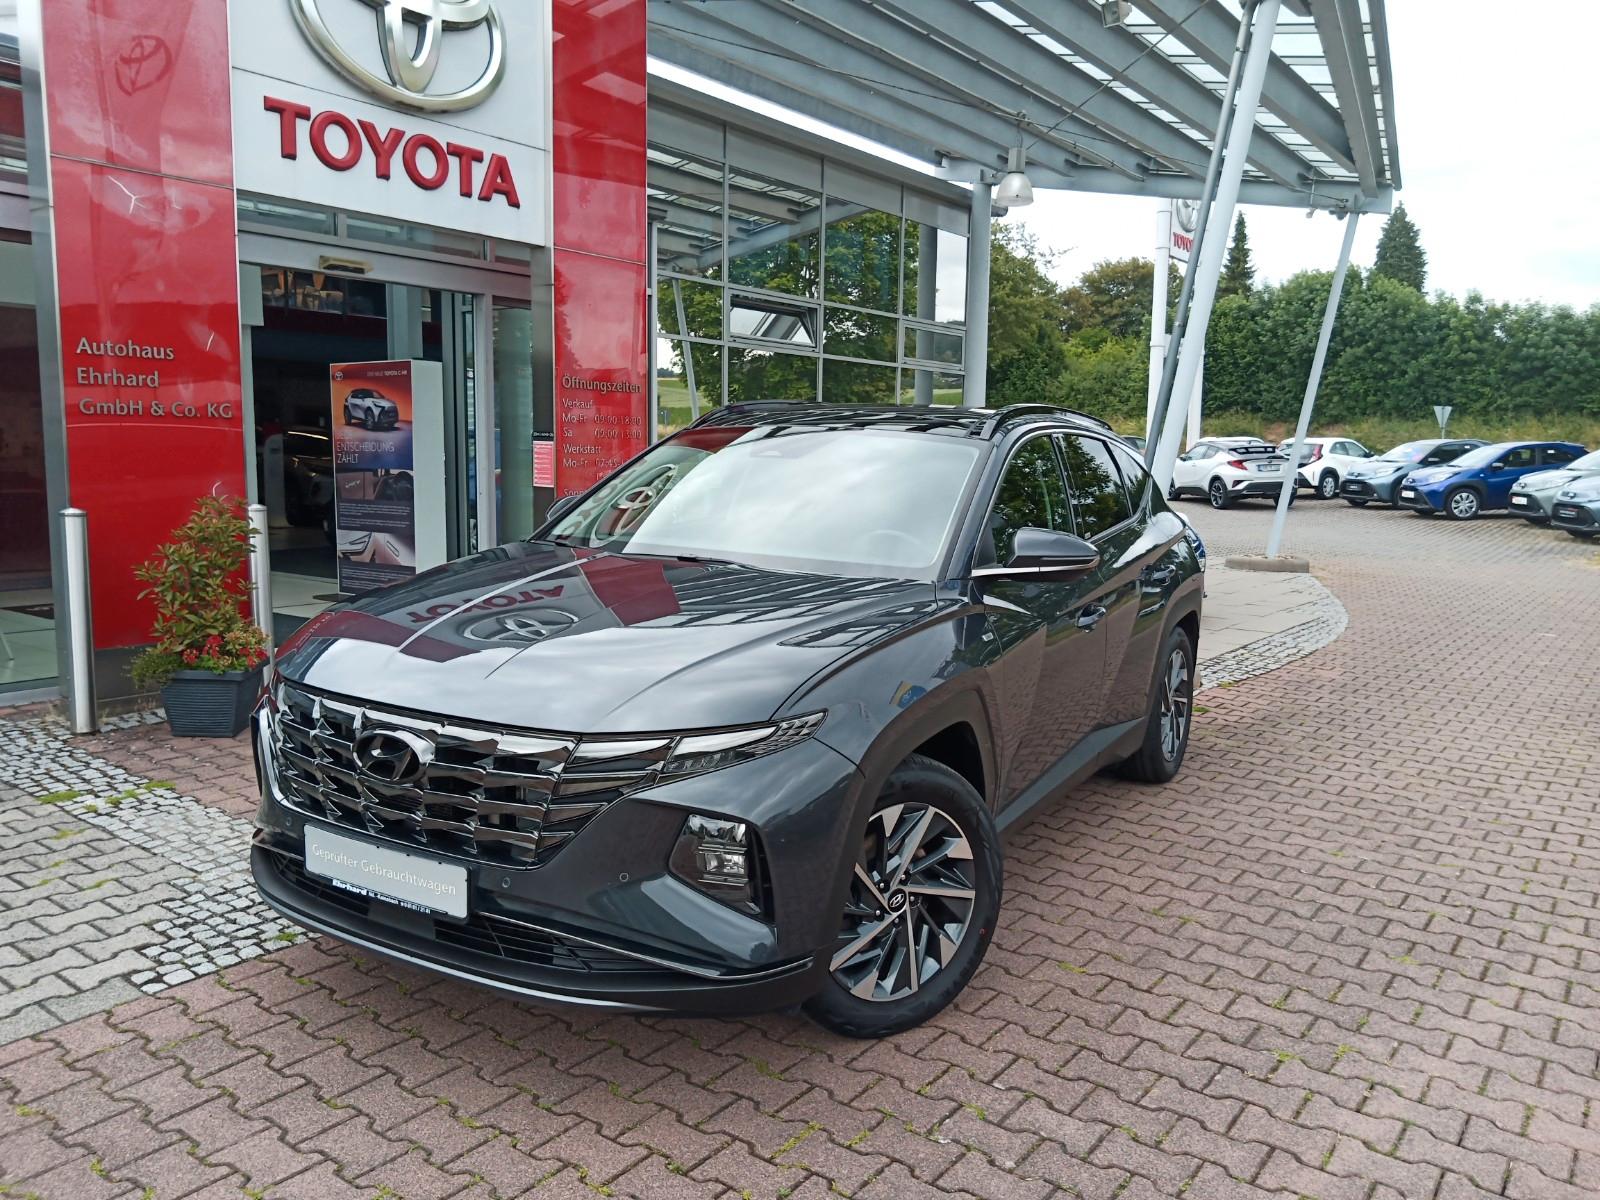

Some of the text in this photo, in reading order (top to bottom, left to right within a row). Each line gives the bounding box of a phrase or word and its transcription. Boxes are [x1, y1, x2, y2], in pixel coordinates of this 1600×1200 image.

[263, 95, 521, 209] TOYOTA
[1173, 232, 1193, 252] TOYO
[76, 336, 175, 360] Autohaus
[77, 366, 160, 388] Ehrhard
[562, 374, 642, 394] Öffnungszeiten
[79, 398, 233, 418] GmbH & Co. KG
[562, 399, 593, 410] Verkauf
[336, 441, 395, 452] ENTSCHEIDUNG
[563, 445, 601, 455] Werkstatt
[332, 878, 368, 896] Ehrhard
[361, 859, 456, 896] Gebrauchtwagen
